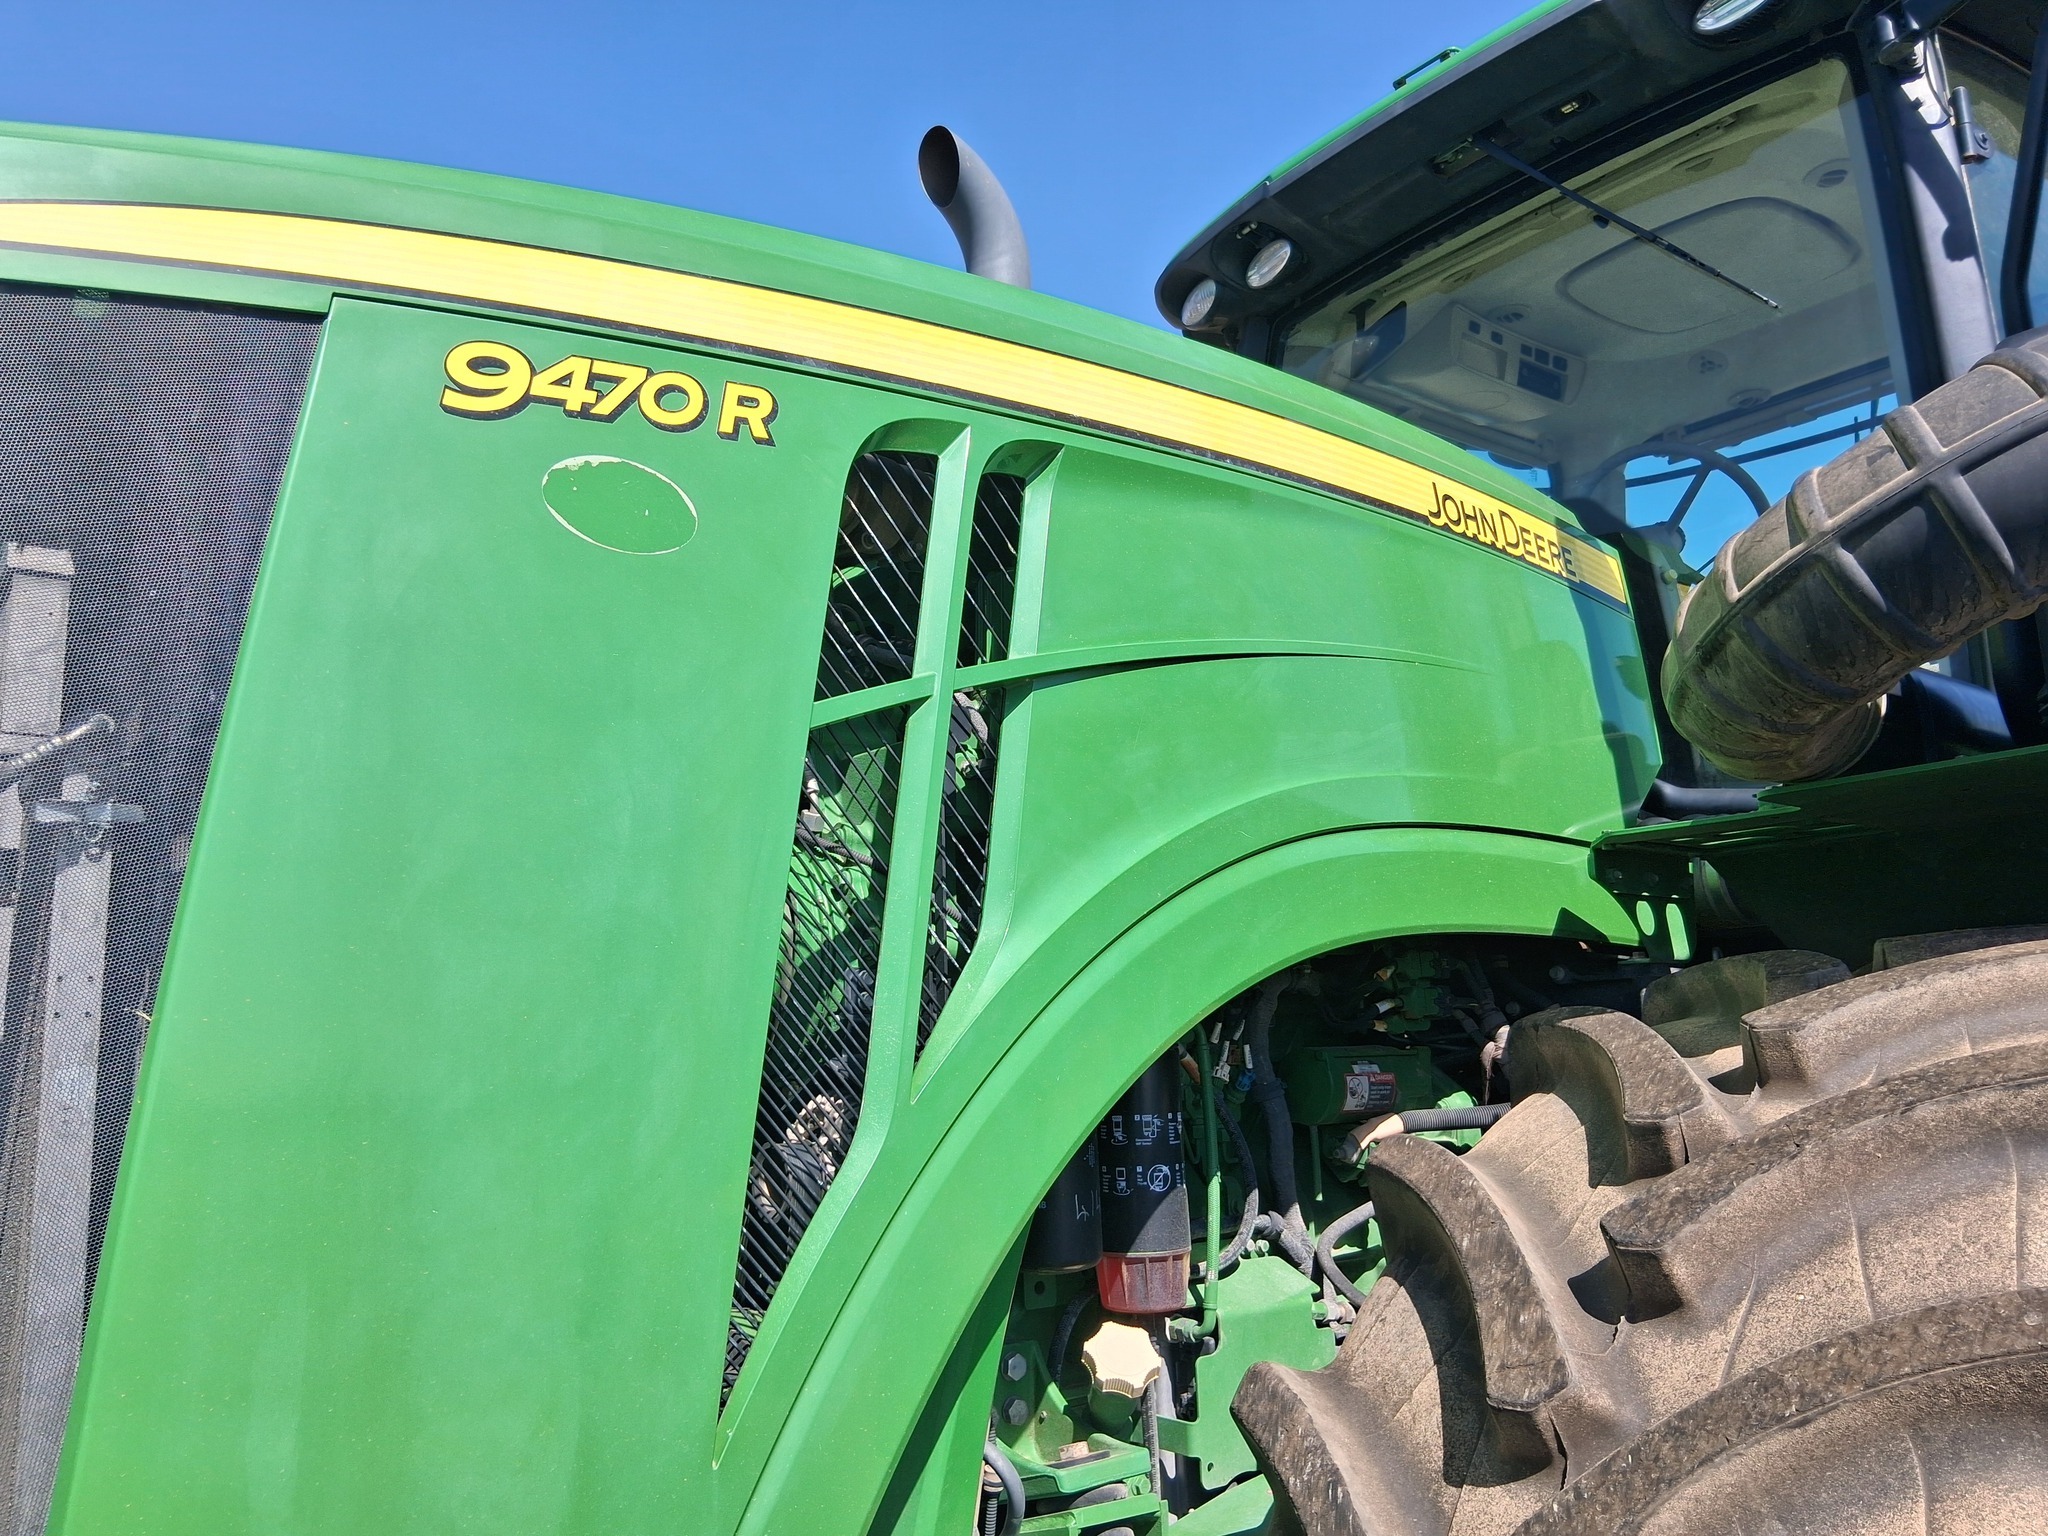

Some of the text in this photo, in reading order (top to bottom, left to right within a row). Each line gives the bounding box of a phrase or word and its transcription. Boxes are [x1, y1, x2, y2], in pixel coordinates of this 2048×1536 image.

[439, 340, 710, 433] 9470
[1428, 482, 1577, 578] JOHN DEERE
